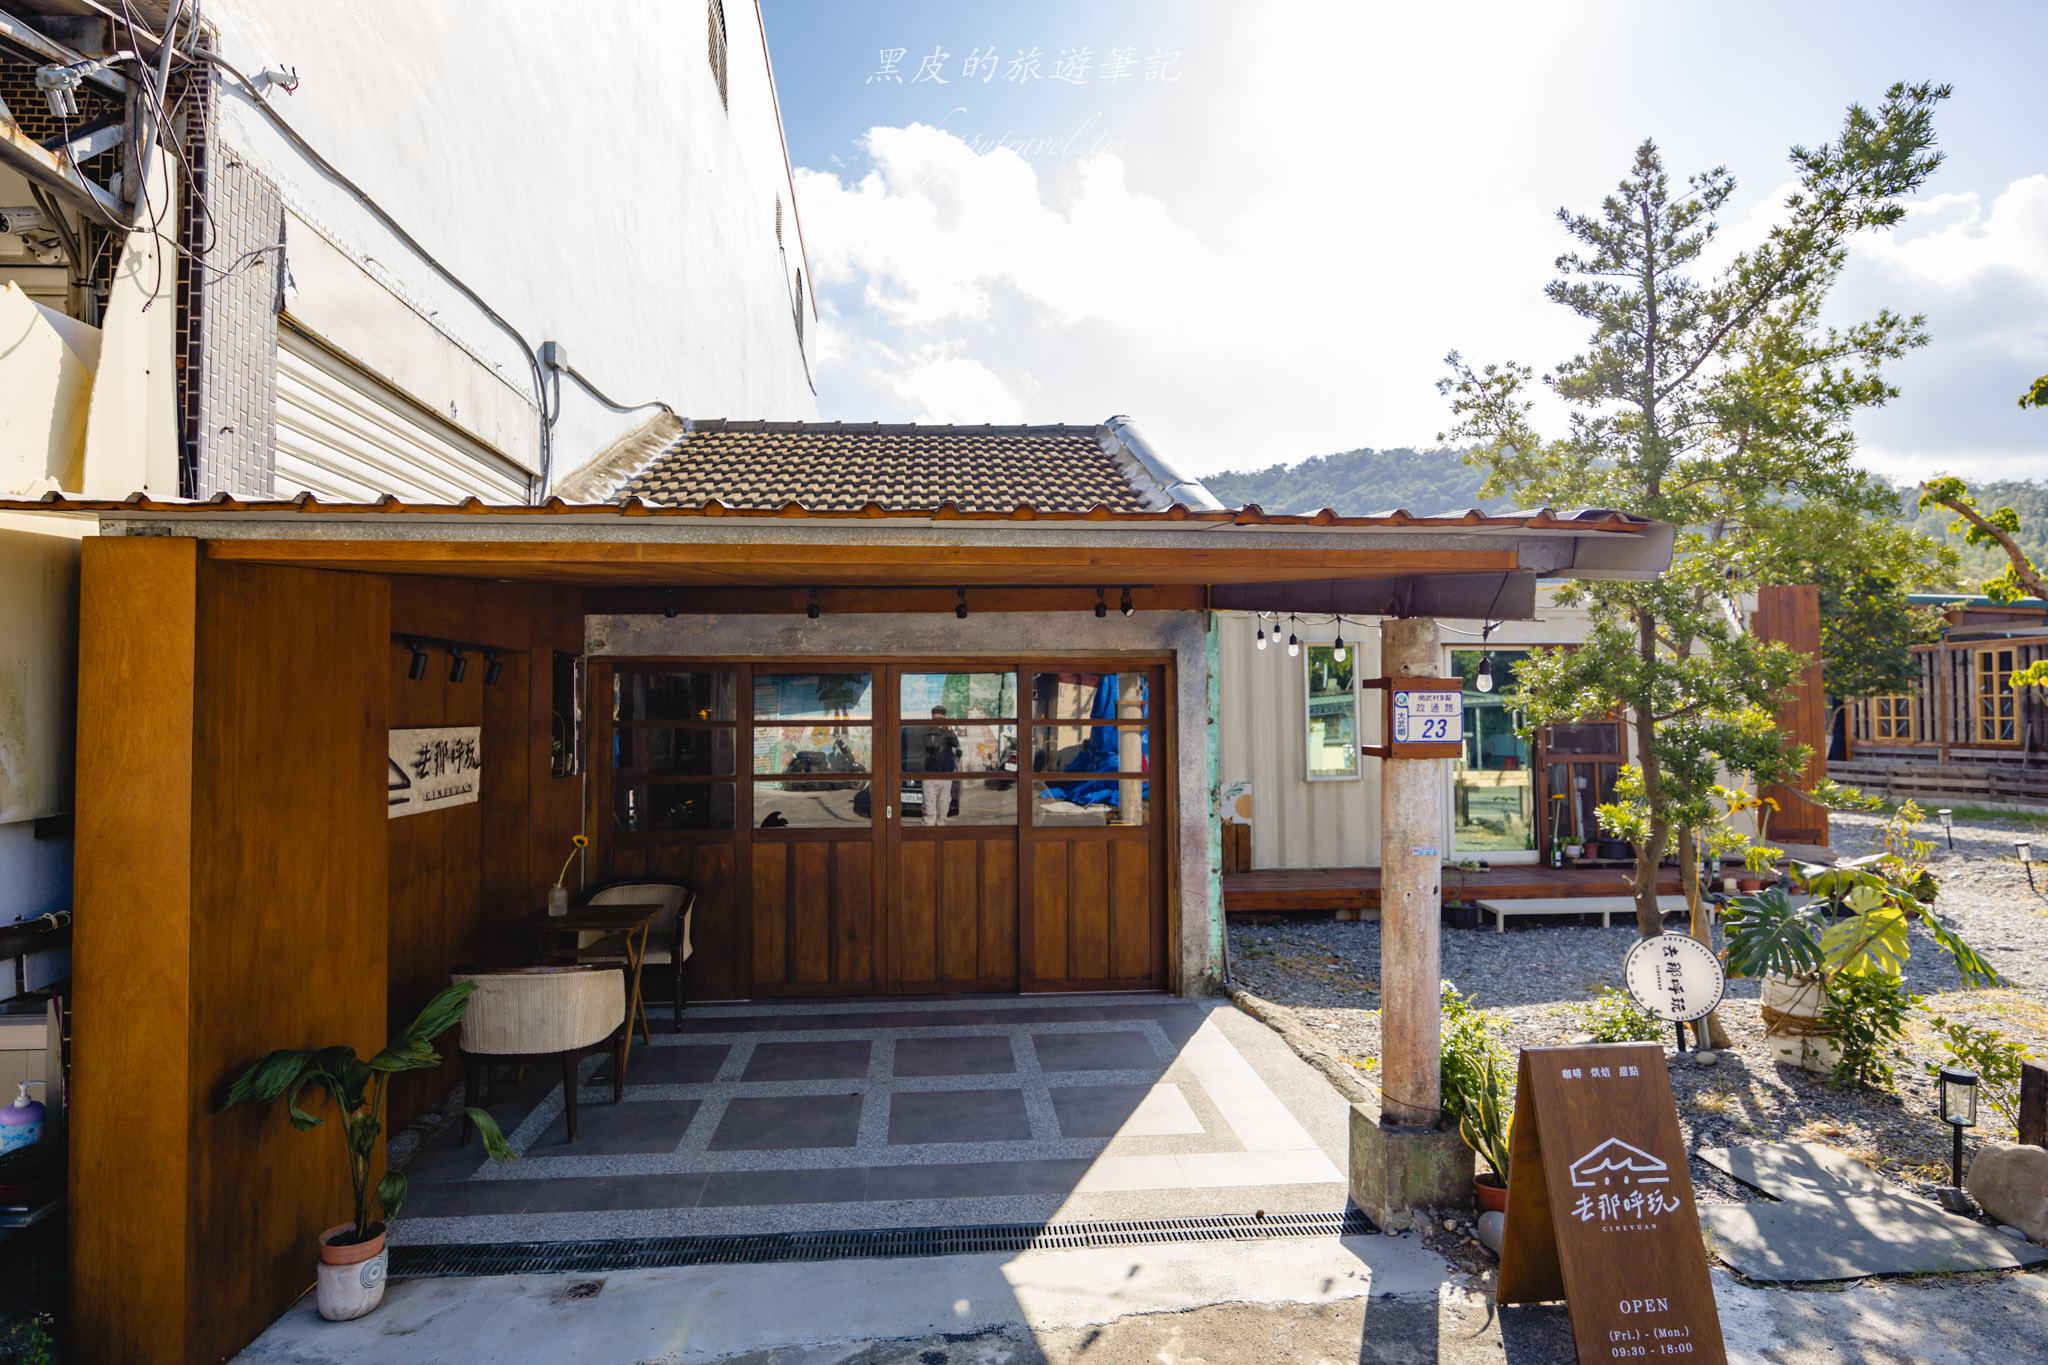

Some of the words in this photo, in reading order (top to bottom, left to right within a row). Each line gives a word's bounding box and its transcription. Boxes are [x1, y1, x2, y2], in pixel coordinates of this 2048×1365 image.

[1416, 703, 1454, 713] 政通路
[1422, 719, 1447, 738] 23
[1571, 1189, 1681, 1222] 去那呼玩
[1619, 1298, 1669, 1314] OPEN
[1609, 1330, 1640, 1342] (Fri.)
[1653, 1326, 1690, 1339] (Mon.)
[1612, 1345, 1645, 1358] 09:30
[1660, 1343, 1693, 1355] 18:00
